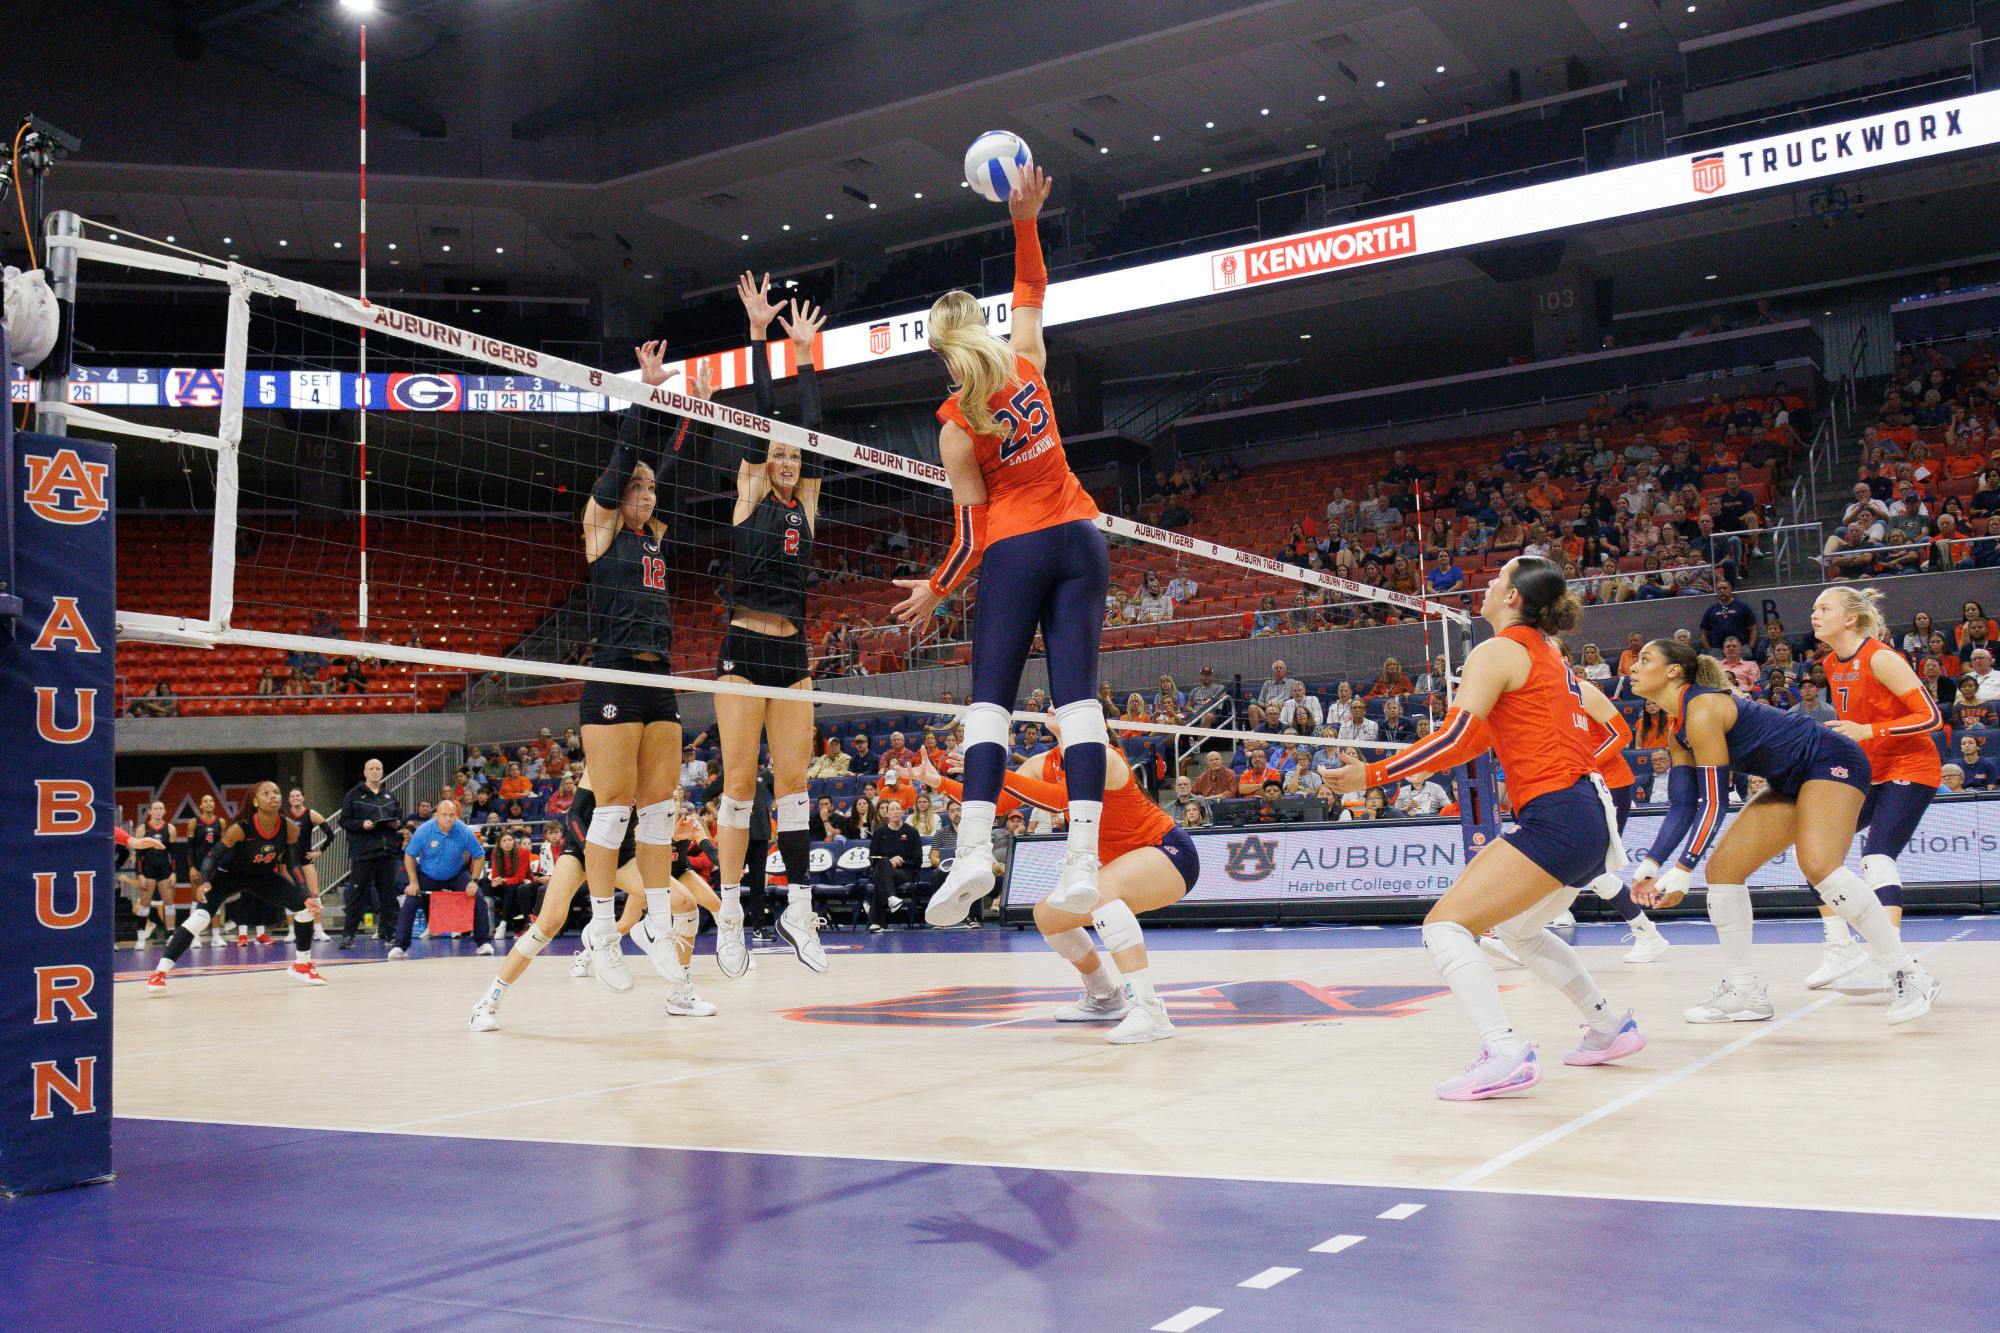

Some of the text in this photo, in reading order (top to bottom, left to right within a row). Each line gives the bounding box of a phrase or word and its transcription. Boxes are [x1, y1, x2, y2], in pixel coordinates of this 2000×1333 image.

[1739, 109, 1962, 176] TRUCKWORX
[1250, 222, 1410, 277] KENWORTH
[374, 310, 538, 368] AUBURN TIGERS
[17, 366, 148, 382] 1 3 4 5
[299, 375, 332, 386] SET
[478, 377, 484, 389] 1
[504, 377, 514, 390] 2
[533, 377, 542, 390] 3
[73, 385, 92, 401] 26
[259, 375, 276, 405] 5
[311, 388, 320, 404] 4
[474, 393, 545, 410] 19 25 24
[650, 389, 771, 433] AUBURN TIGERS
[992, 380, 1049, 462] 25
[853, 445, 947, 482] AUBURN TIGERS
[784, 528, 801, 556] 2
[1134, 523, 1194, 549] AUBURN TIGERS
[641, 556, 666, 590] 12
[1235, 551, 1285, 573] AUBURN TIGERS
[1318, 574, 1360, 592] AUBURN TIGERS
[602, 704, 619, 719] SEC
[1837, 687, 1848, 712] 7
[31, 596, 102, 1121] AUBURN
[1290, 843, 1456, 870] AUBURN
[1288, 880, 1347, 893] Harbert
[1351, 877, 1412, 893] College
[1416, 875, 1433, 889] of
